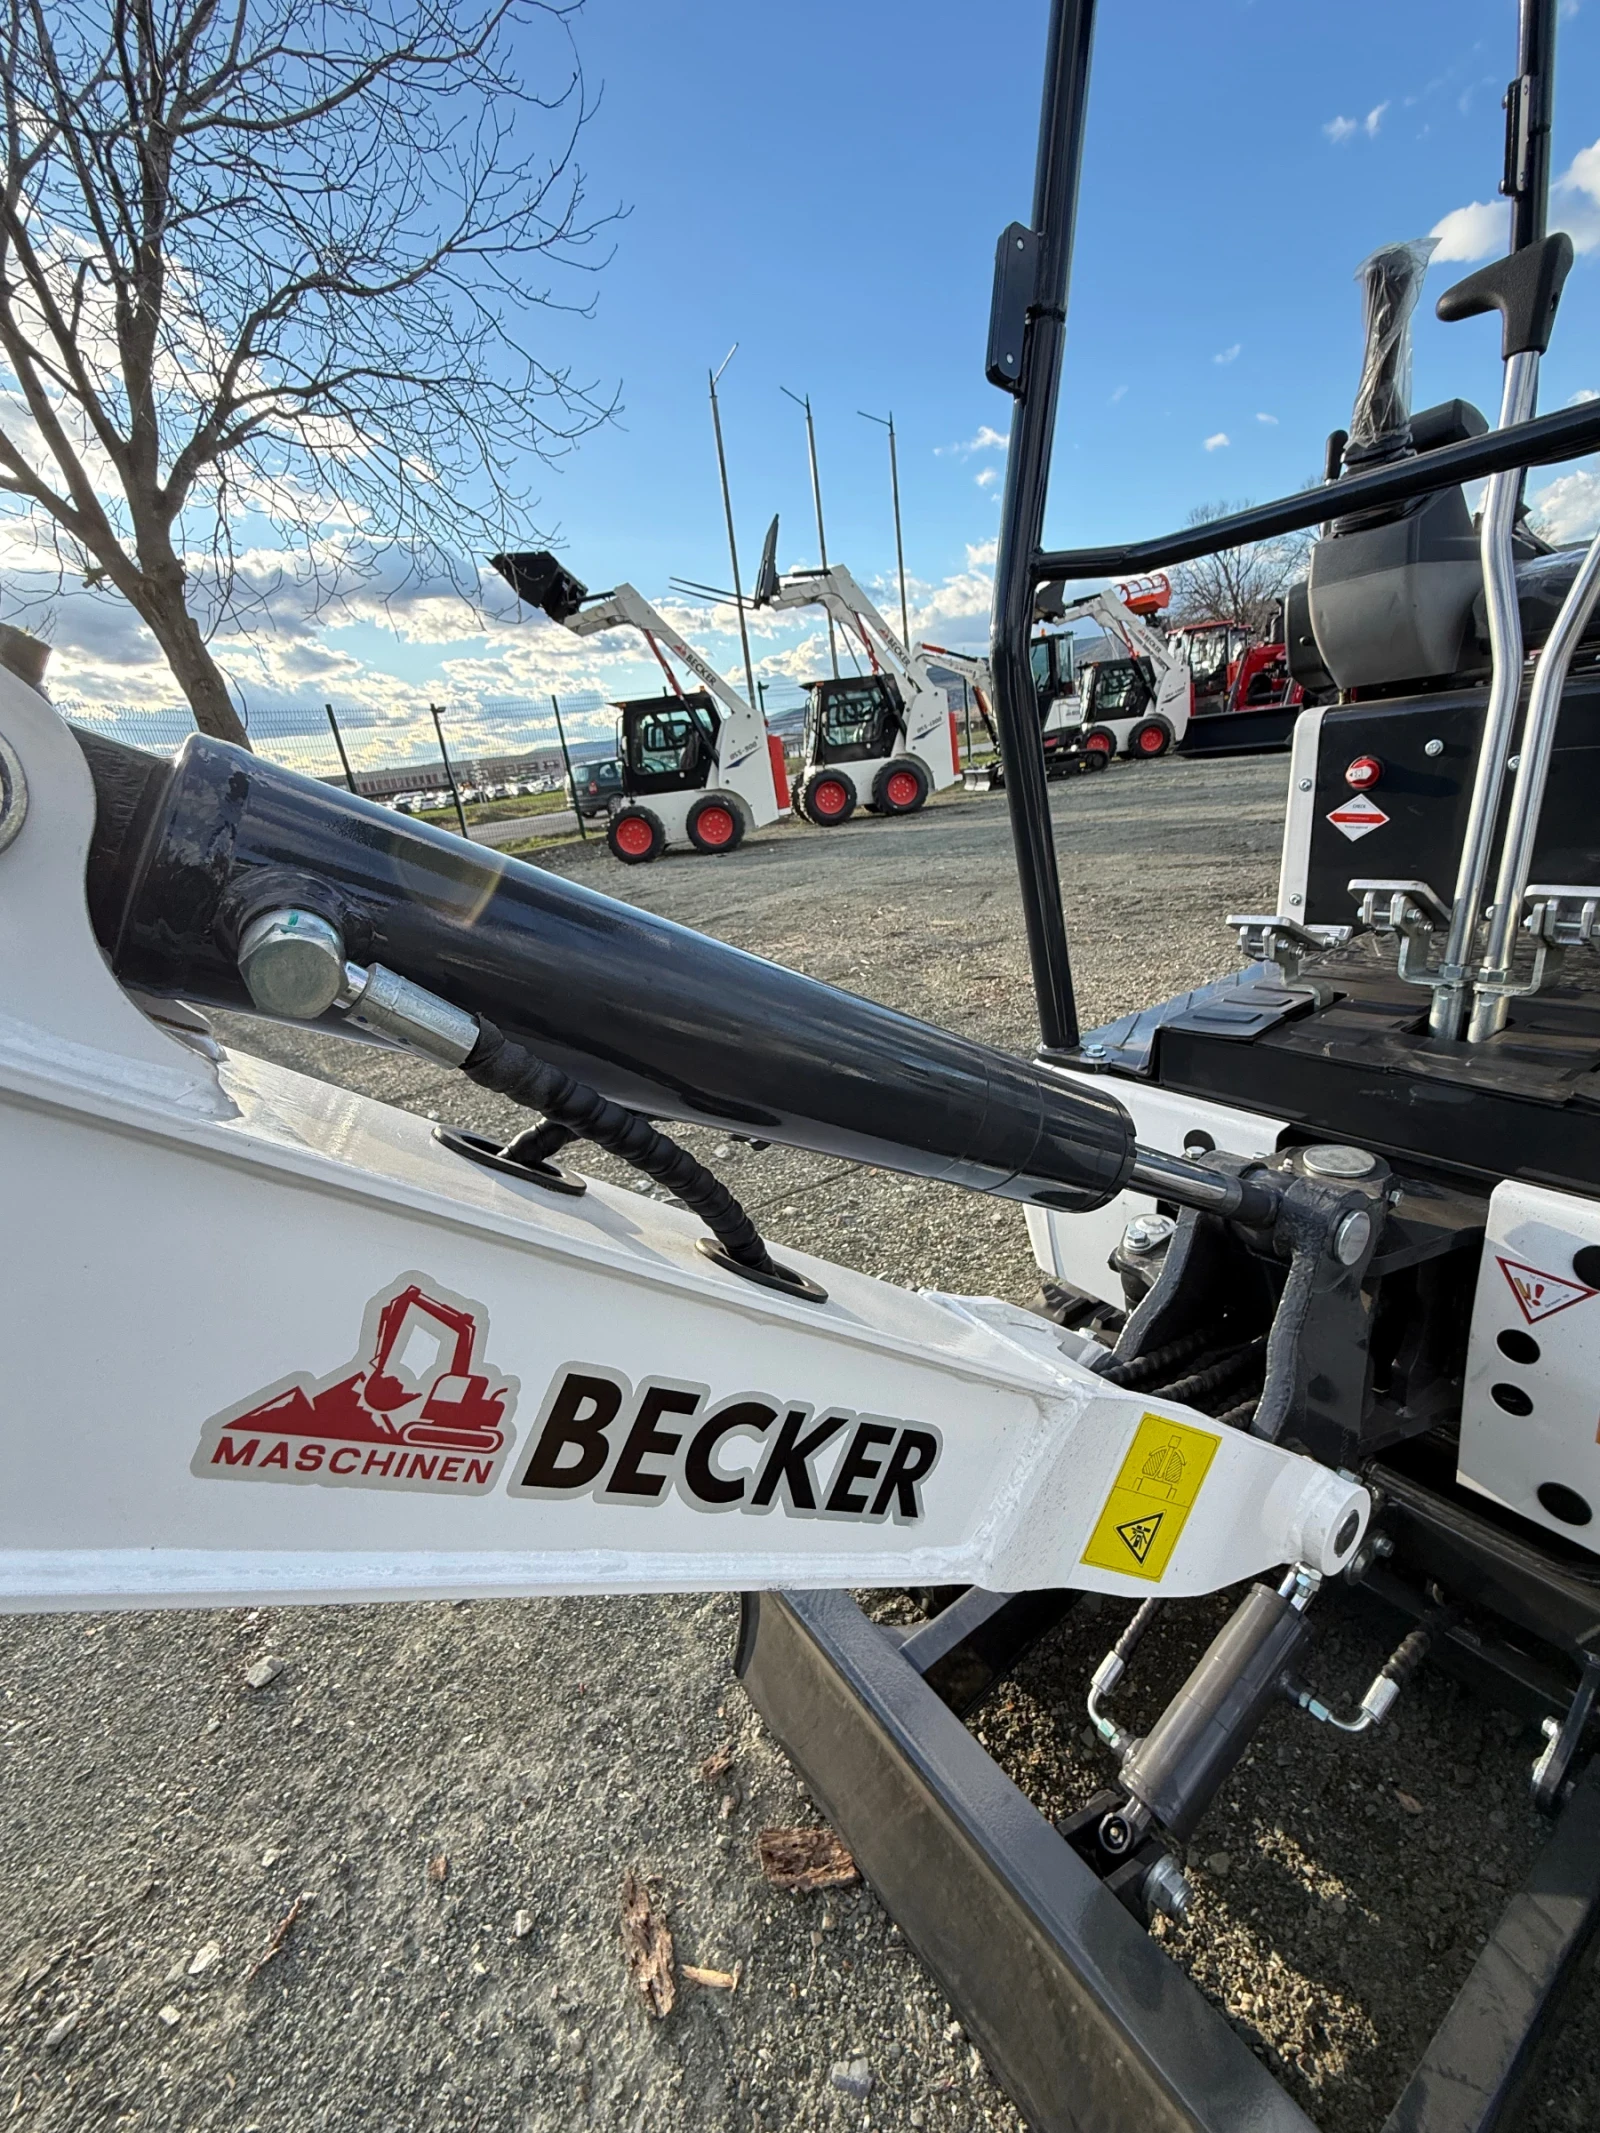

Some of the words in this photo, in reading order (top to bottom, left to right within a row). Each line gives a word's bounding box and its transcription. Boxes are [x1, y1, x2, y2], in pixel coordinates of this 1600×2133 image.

[686, 654, 717, 686] BECKER
[887, 637, 910, 666] BECKER
[211, 1437, 494, 1485] MASCHINEN
[521, 1373, 938, 1518] BECKER
